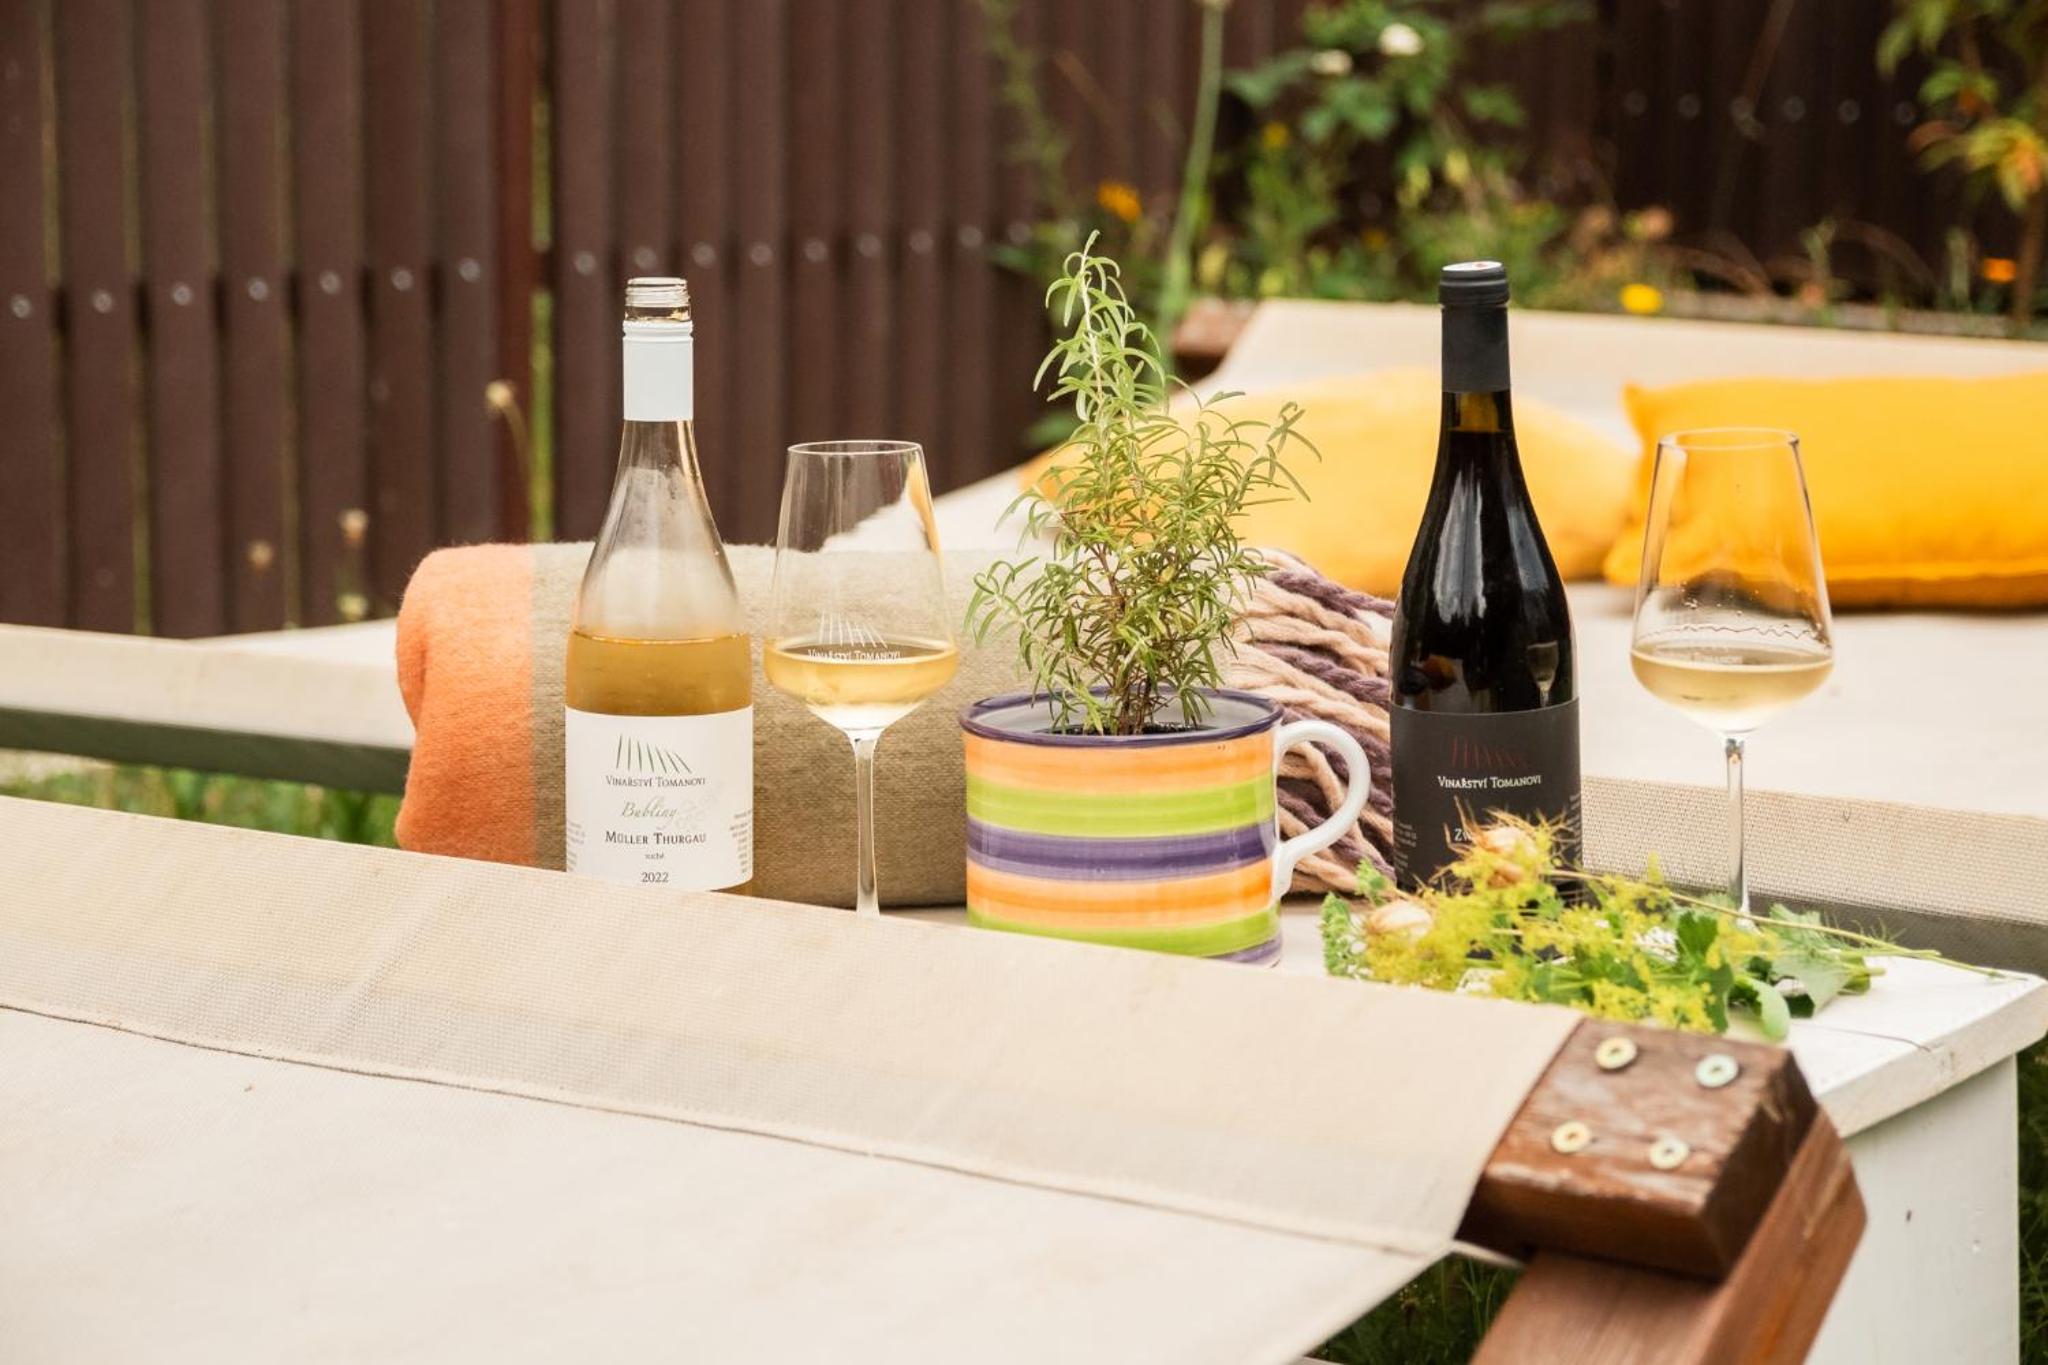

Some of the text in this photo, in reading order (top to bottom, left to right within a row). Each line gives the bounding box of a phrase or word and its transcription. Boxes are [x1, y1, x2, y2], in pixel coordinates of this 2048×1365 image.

[656, 776, 705, 787] TOMANOVI
[1437, 775, 1541, 788] VINAŘSTVÍ TOMANOVI
[653, 832, 706, 845] THURGAU
[641, 872, 669, 883] 2022
